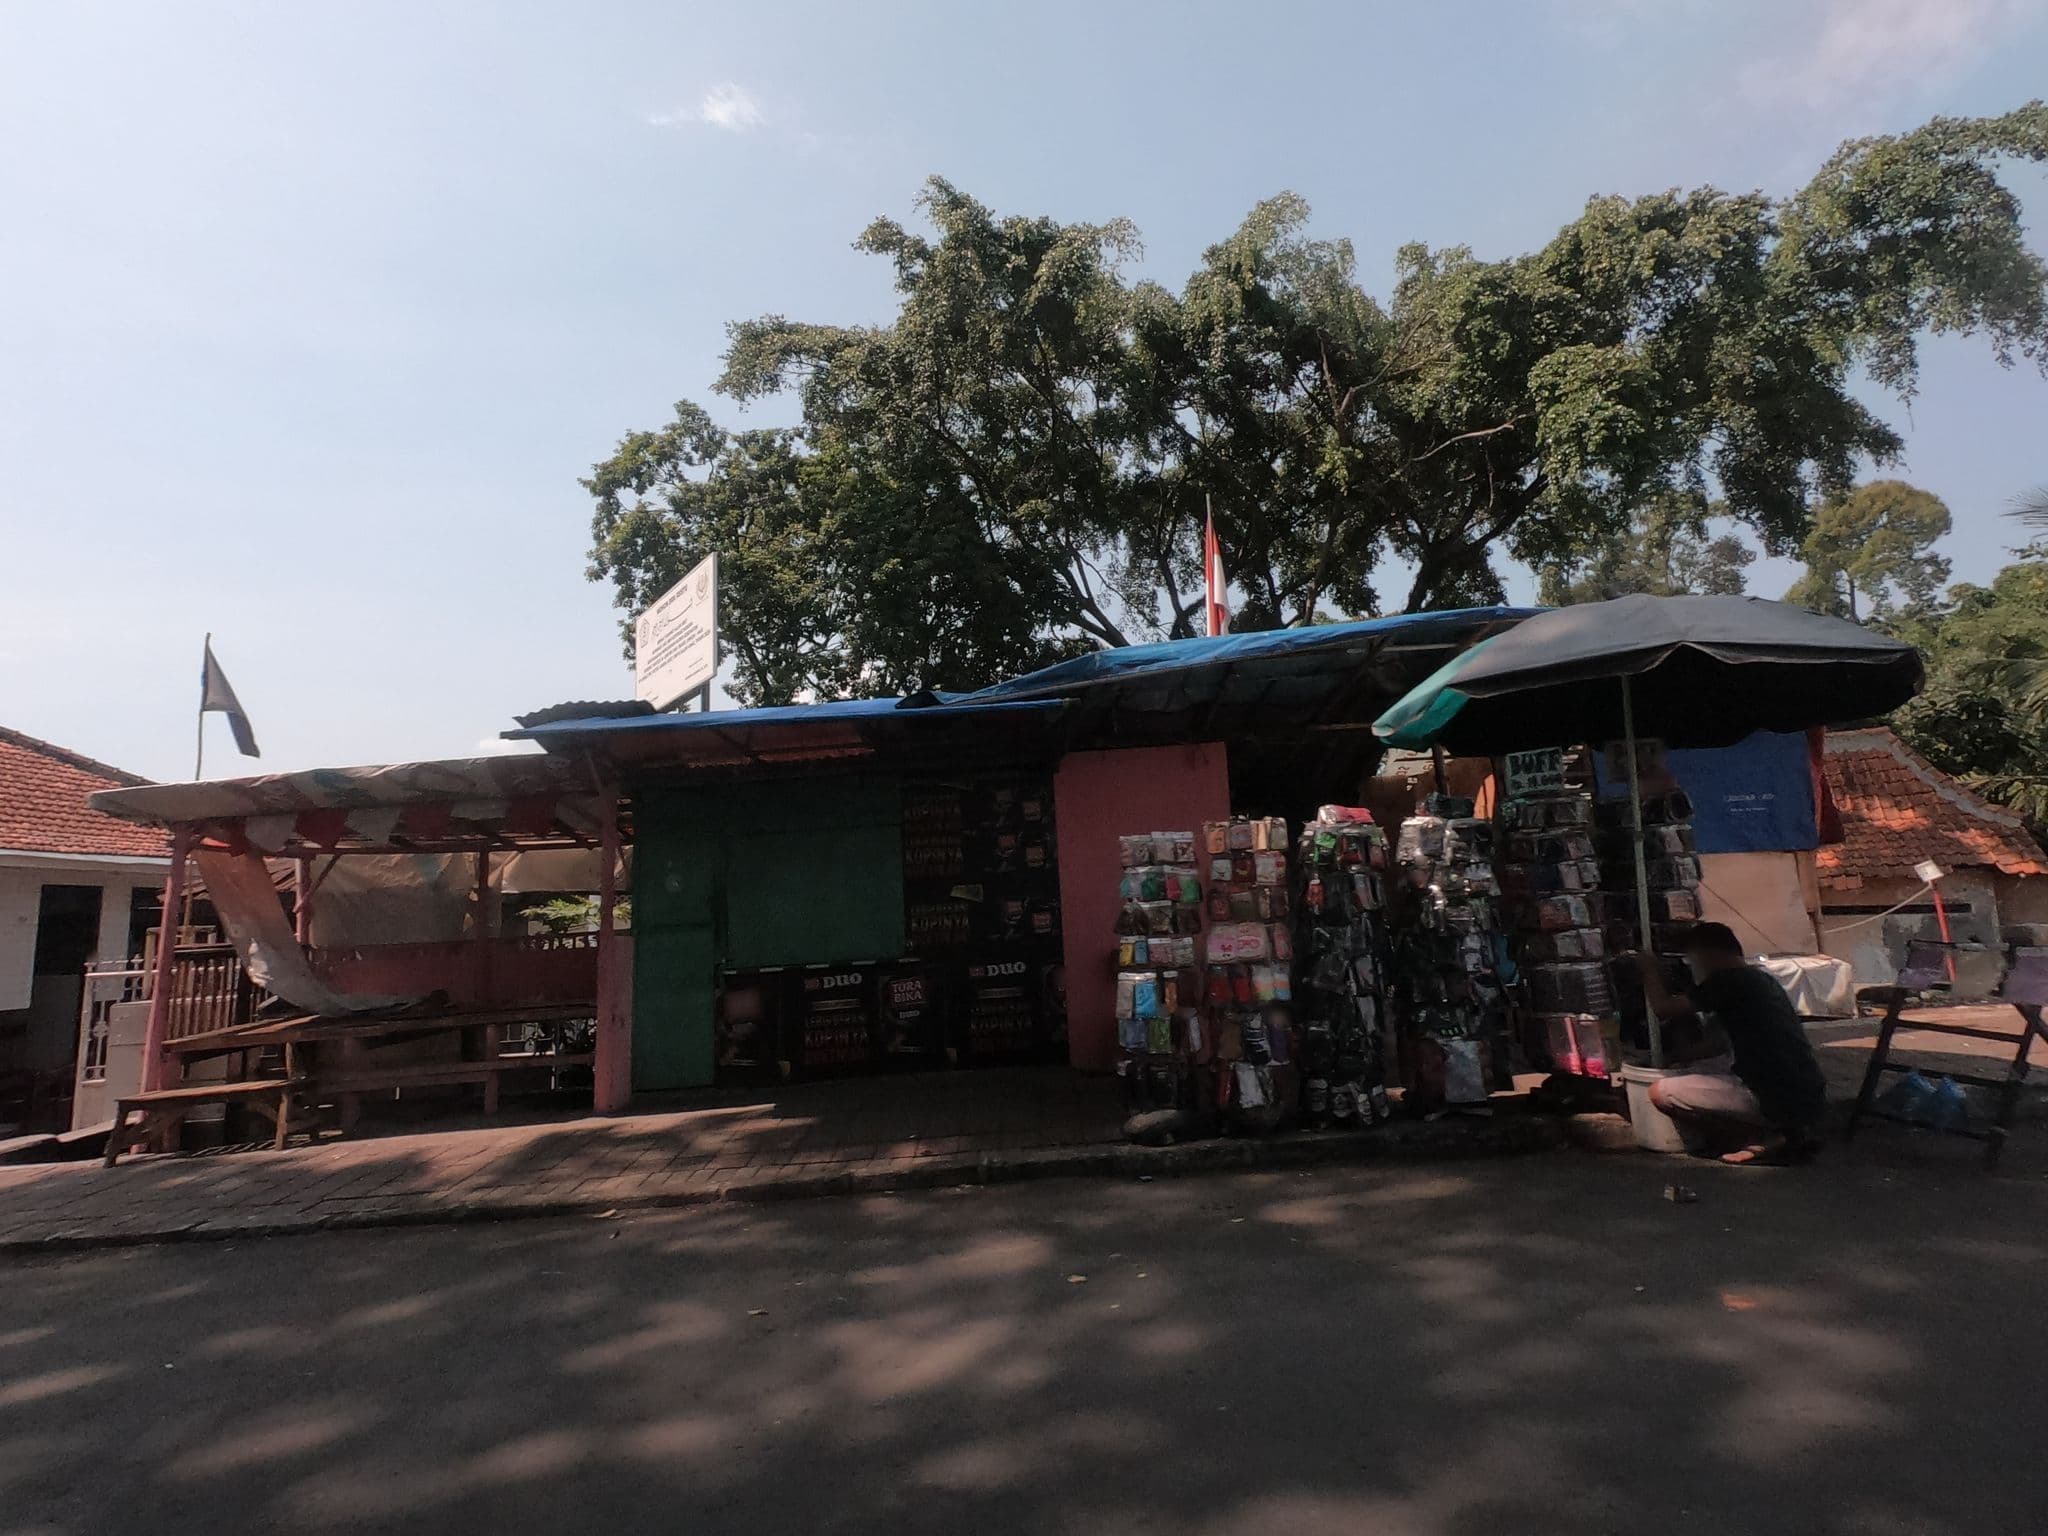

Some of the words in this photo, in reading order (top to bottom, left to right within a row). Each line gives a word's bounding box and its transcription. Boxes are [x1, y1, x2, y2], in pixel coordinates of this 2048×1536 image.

[986, 961, 1025, 977] DUO
[823, 972, 863, 989] DUO
[894, 991, 922, 1003] BIKA
